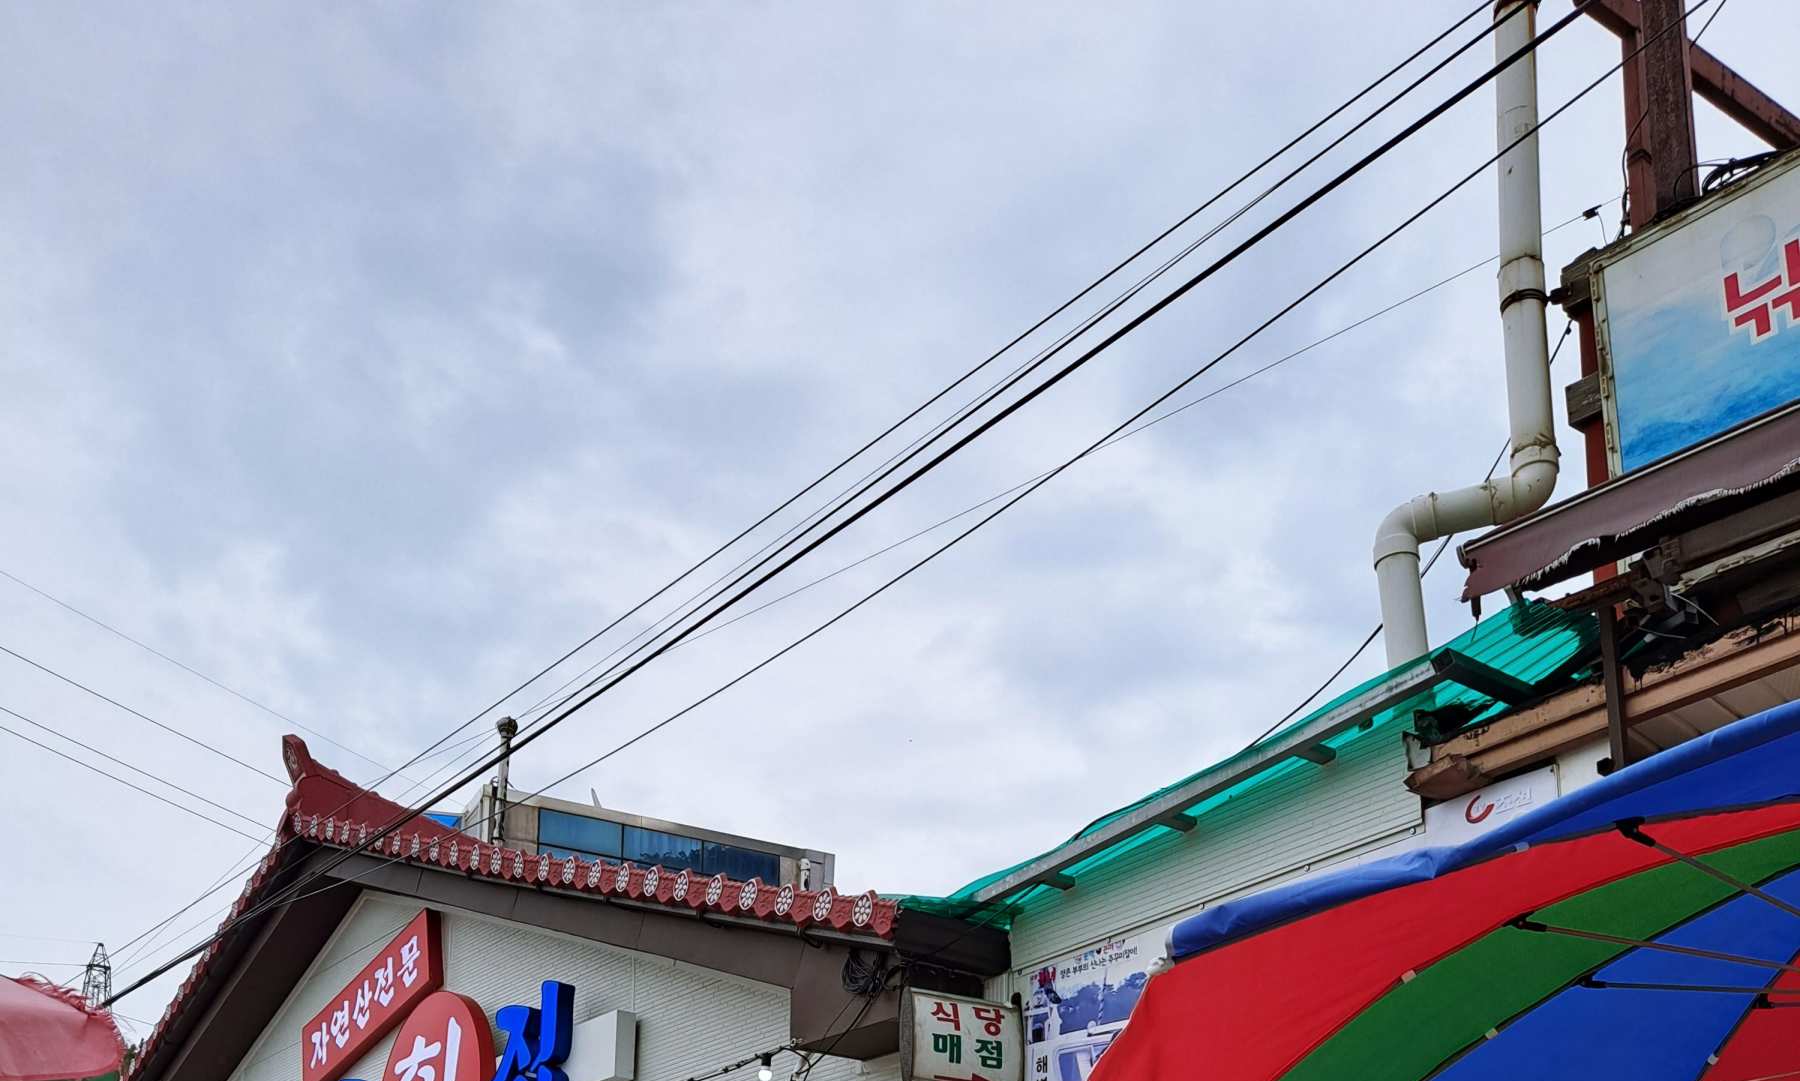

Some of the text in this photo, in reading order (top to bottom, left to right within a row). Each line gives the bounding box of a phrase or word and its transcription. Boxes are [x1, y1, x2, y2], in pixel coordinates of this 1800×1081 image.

[308, 934, 421, 1070] 자연산전문
[931, 1000, 1006, 1037] 식당
[931, 1032, 1004, 1070] 매점
